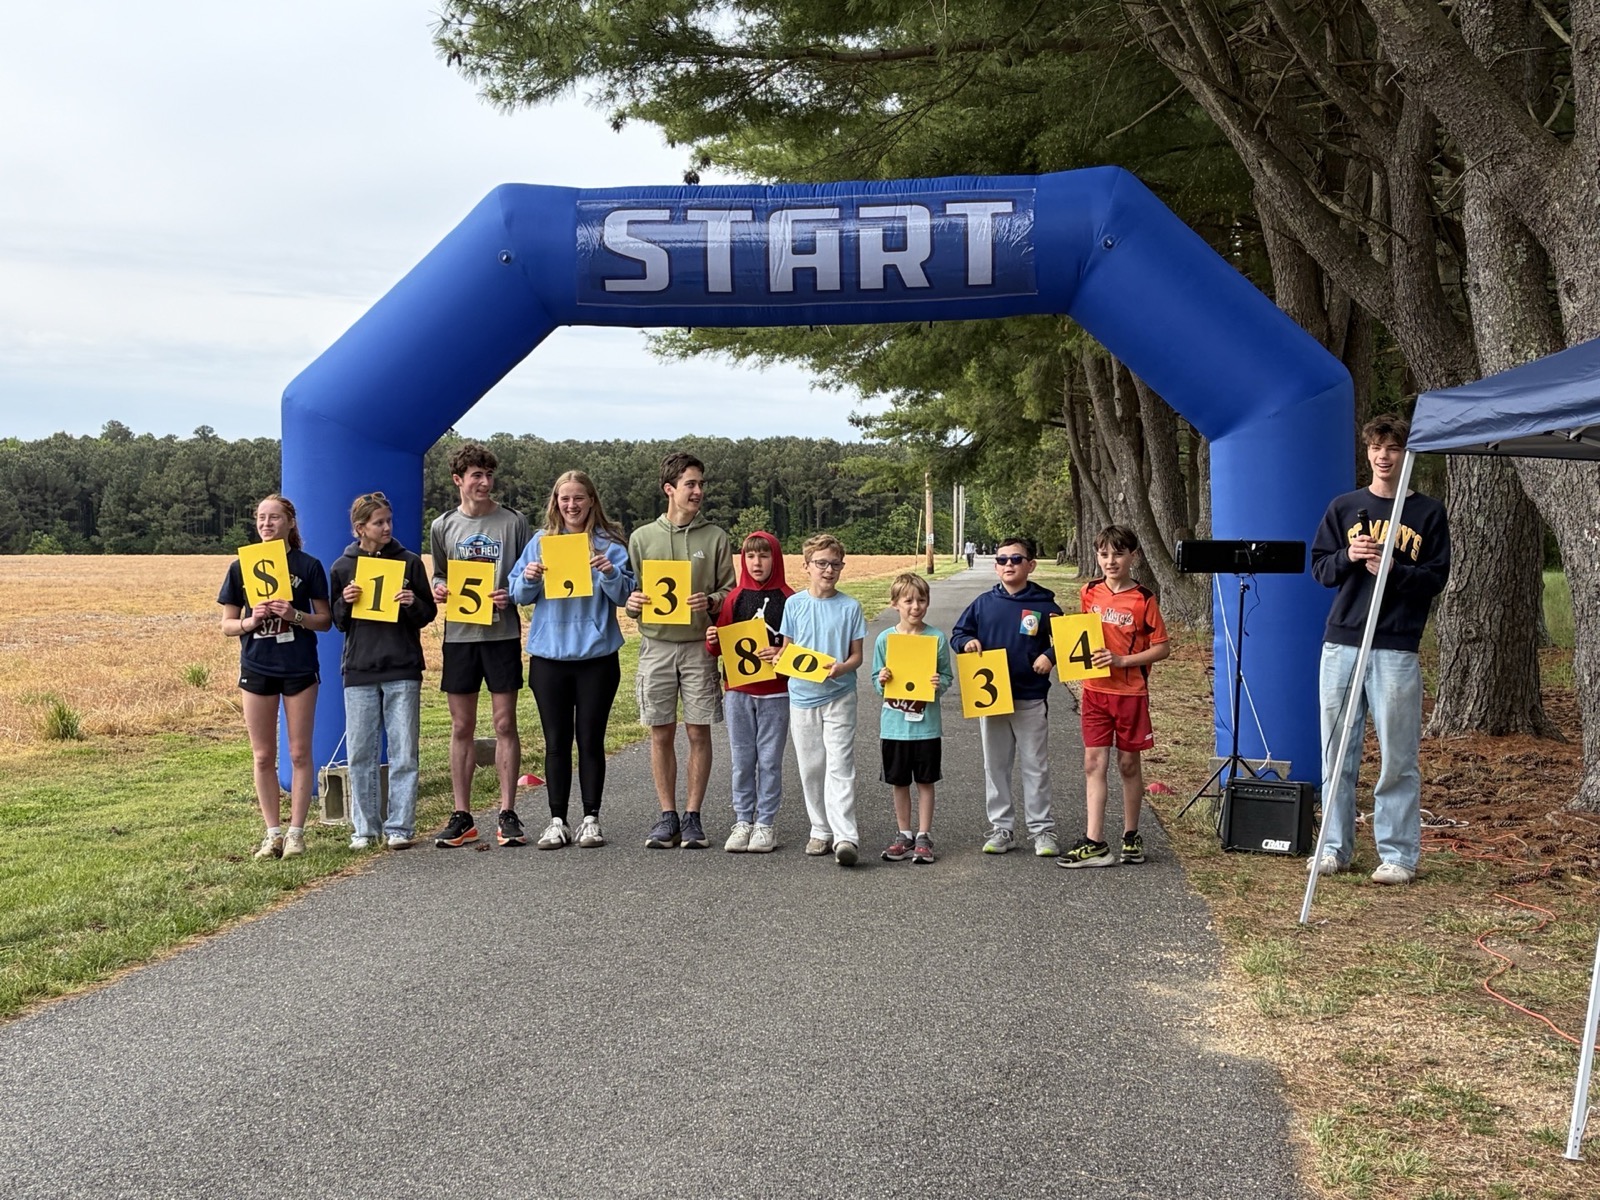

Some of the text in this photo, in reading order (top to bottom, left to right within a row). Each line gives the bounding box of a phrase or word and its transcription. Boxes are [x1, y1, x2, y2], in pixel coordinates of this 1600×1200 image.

[603, 201, 1013, 293] START
[253, 559, 279, 599] $
[366, 575, 385, 612] 1
[459, 578, 483, 615] 5
[653, 577, 678, 616] 3
[260, 617, 282, 636] 327
[734, 637, 762, 676] 8
[1069, 630, 1095, 670] 4
[972, 668, 998, 708] 3
[1262, 839, 1291, 851] CRATE
